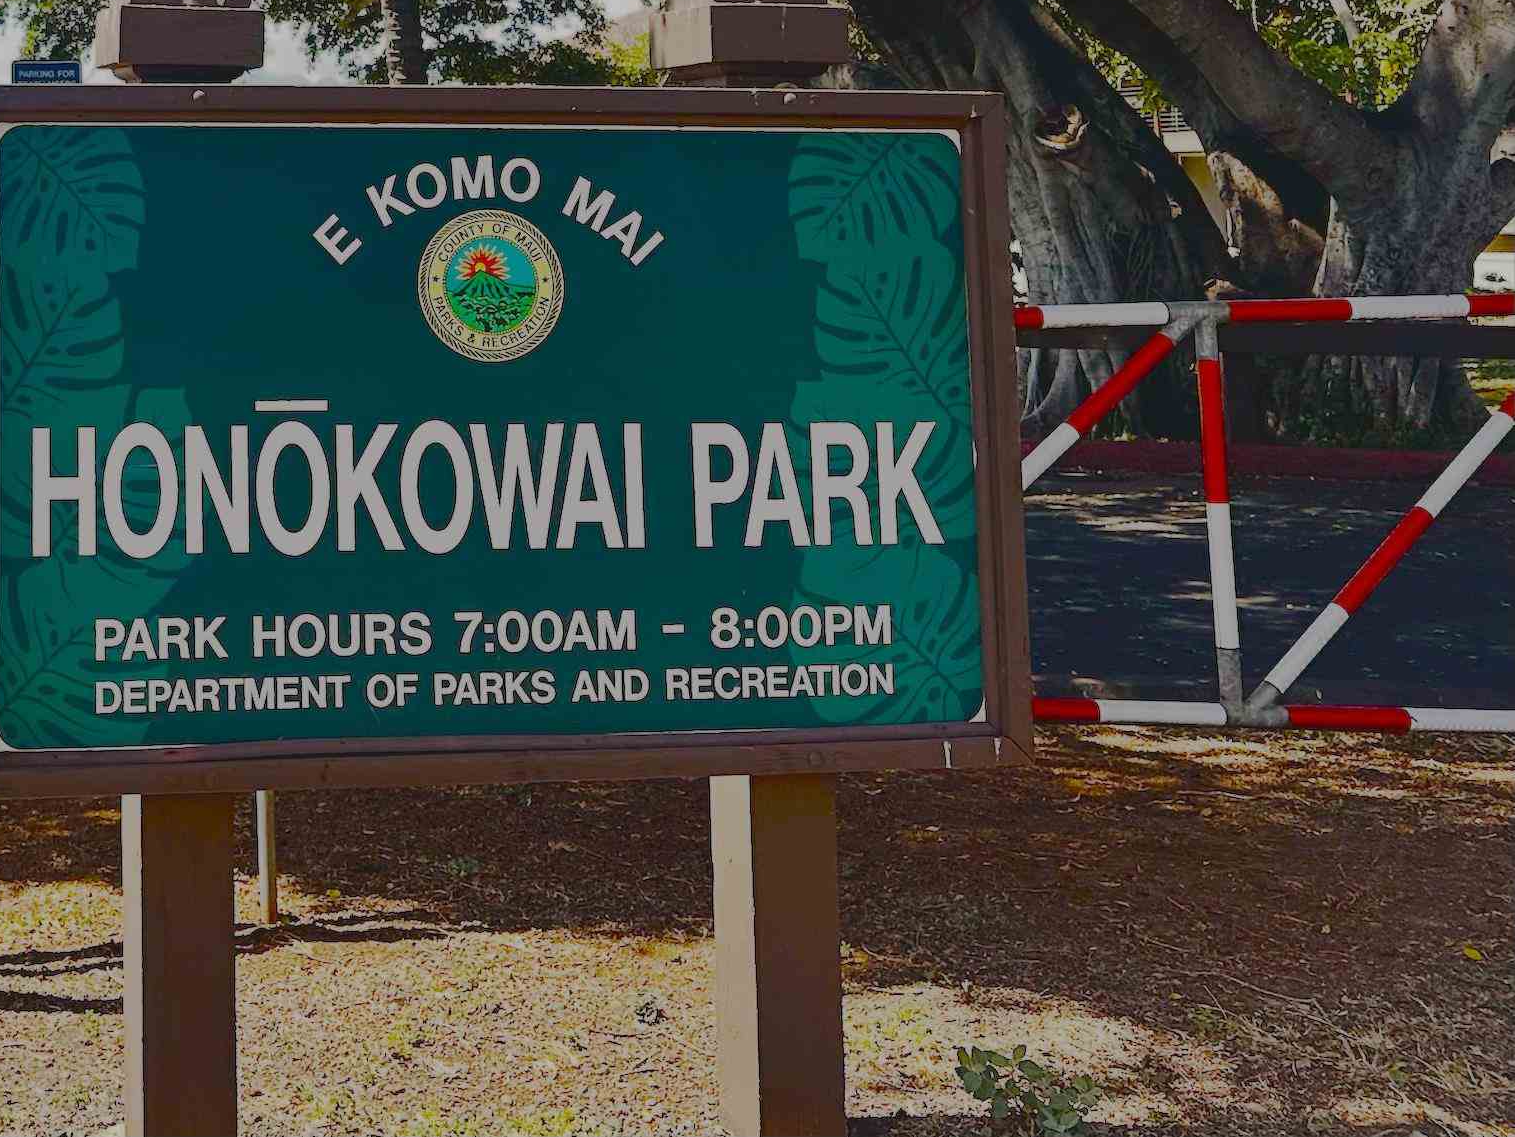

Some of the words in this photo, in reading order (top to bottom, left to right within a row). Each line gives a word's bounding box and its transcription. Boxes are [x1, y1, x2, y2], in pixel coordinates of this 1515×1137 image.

[18, 69, 55, 79] PARKING
[57, 69, 76, 79] FOR
[312, 214, 362, 265] E
[366, 155, 541, 227] KOMO
[561, 175, 664, 266] MAI
[438, 223, 485, 263] COUNTY
[492, 222, 510, 235] OF
[515, 231, 543, 263] MAUI
[434, 296, 464, 336] PARKS
[467, 333, 476, 344] &
[482, 296, 550, 348] RECREATION
[691, 421, 945, 548] PARK
[95, 617, 229, 661] PARK
[253, 611, 432, 658] HOURS
[454, 609, 636, 653] 7:00AM
[710, 604, 892, 649] 8:00PM
[95, 674, 351, 714] DEPARTMENT
[366, 673, 419, 708] OF
[433, 670, 556, 706] PARKS
[571, 669, 649, 703] AND
[665, 663, 894, 700] RECREATION
